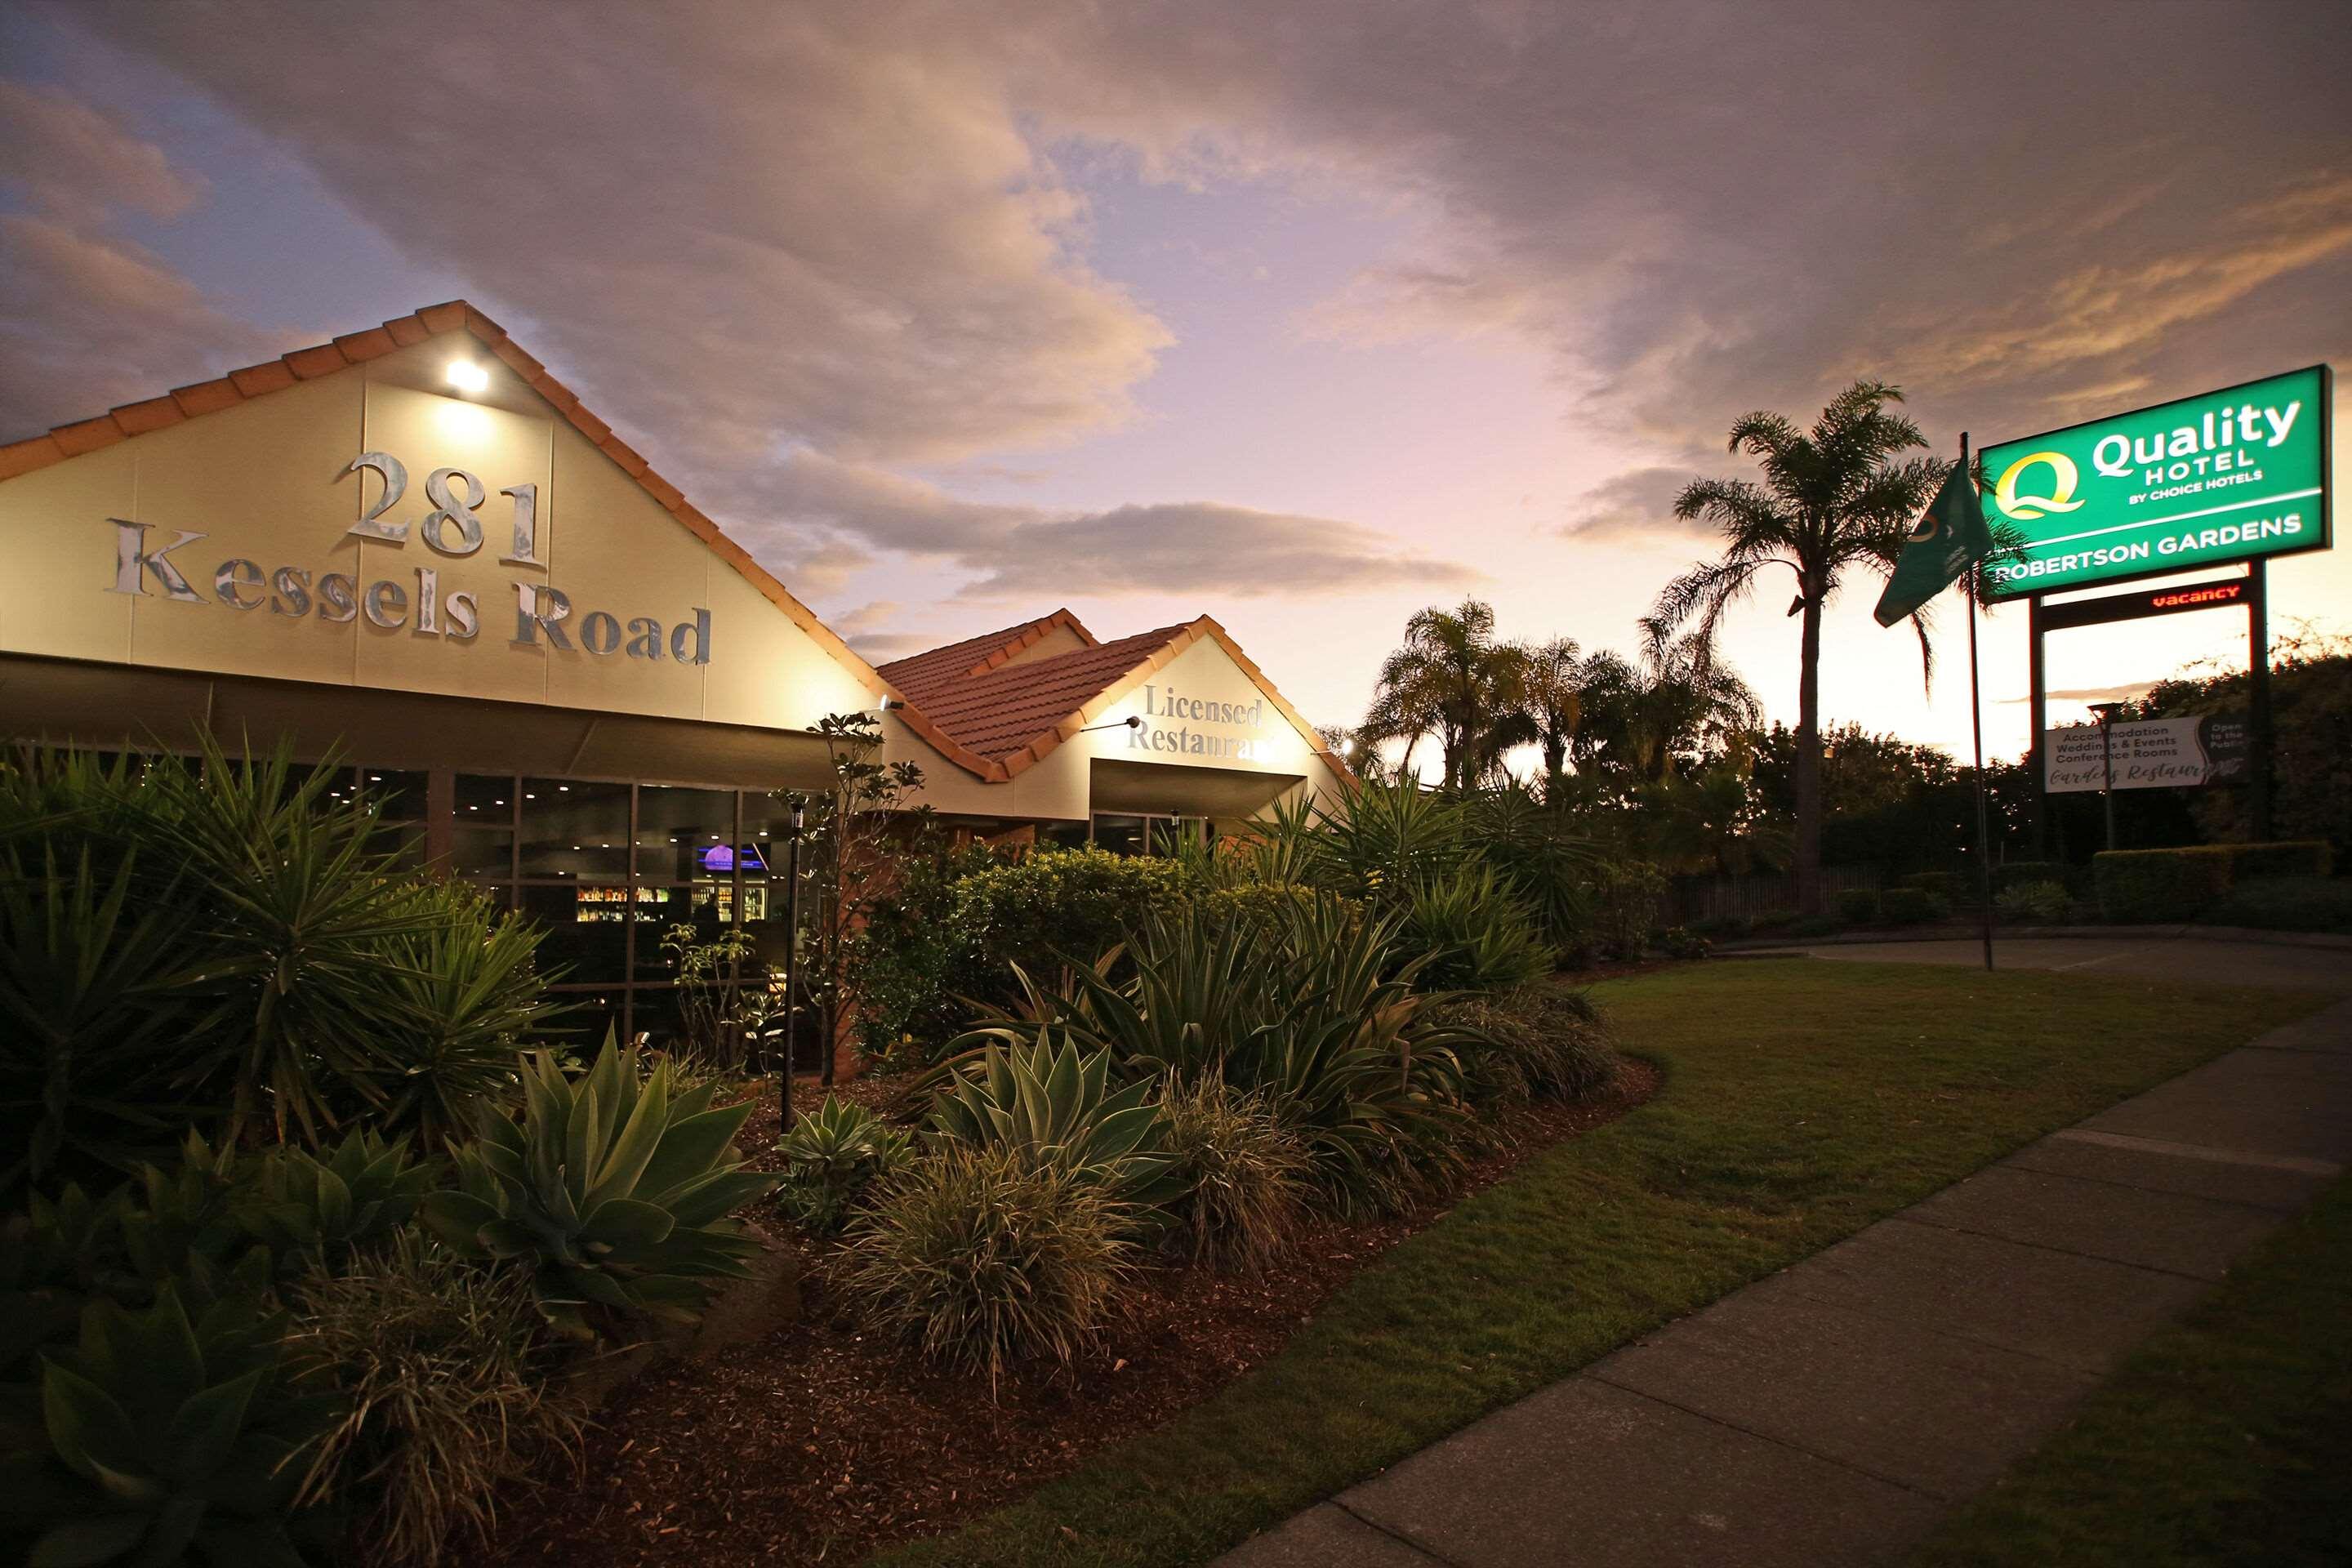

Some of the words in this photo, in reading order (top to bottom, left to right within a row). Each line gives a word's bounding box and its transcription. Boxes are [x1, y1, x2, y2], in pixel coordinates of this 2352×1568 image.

[2092, 400, 2301, 477] Quality
[1994, 452, 2086, 520] Q
[2128, 492, 2147, 505] BY
[2149, 483, 2203, 501] CHOICE
[2206, 470, 2263, 491] HOTELS
[2145, 448, 2255, 486] HOTEL
[349, 451, 547, 572] 281
[1994, 541, 2149, 582] ROBERTSON
[2158, 513, 2301, 555] GARDENS
[104, 517, 479, 639] Kessels
[510, 580, 711, 666] Road
[2152, 585, 2240, 608] vacancy
[1144, 684, 1263, 728] Licensed
[1129, 719, 1274, 762] Restaura
[2056, 741, 2117, 753] Weddins
[2121, 739, 2130, 749] &
[2134, 737, 2176, 747] Events
[2134, 747, 2178, 758] Rooms
[2050, 764, 2117, 785] Gardes
